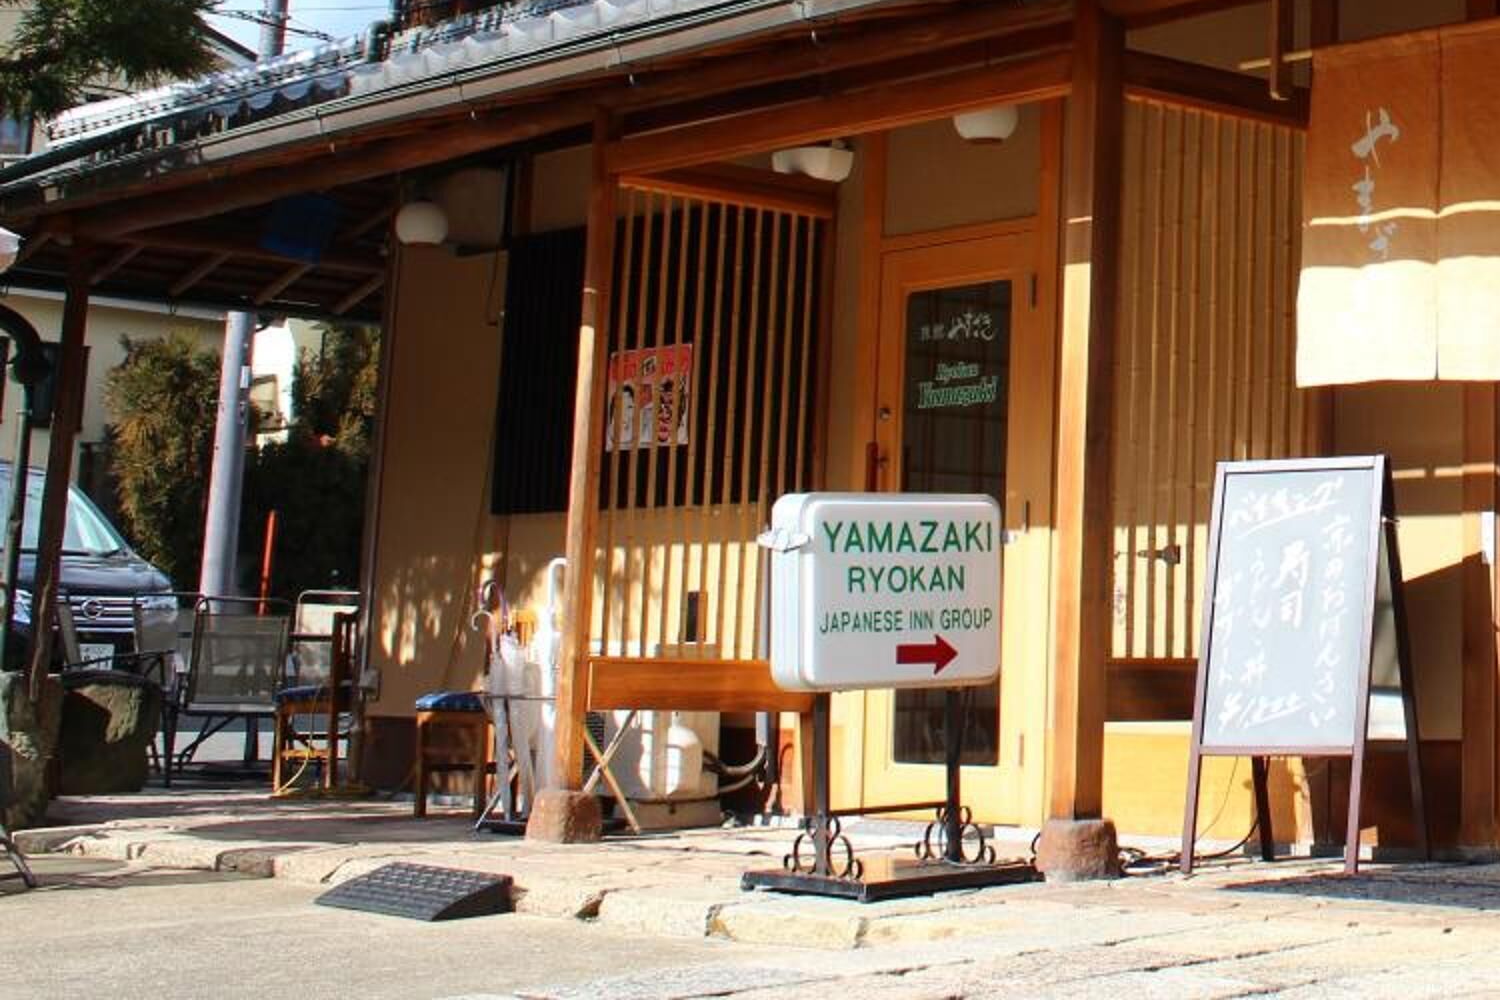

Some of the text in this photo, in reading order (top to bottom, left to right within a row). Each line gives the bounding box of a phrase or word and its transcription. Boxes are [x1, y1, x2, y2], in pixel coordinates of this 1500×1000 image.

[823, 520, 993, 553] YAMAZAKI
[847, 565, 965, 593] RYOKAN
[819, 607, 993, 634] JAPANESE INN GROUP
